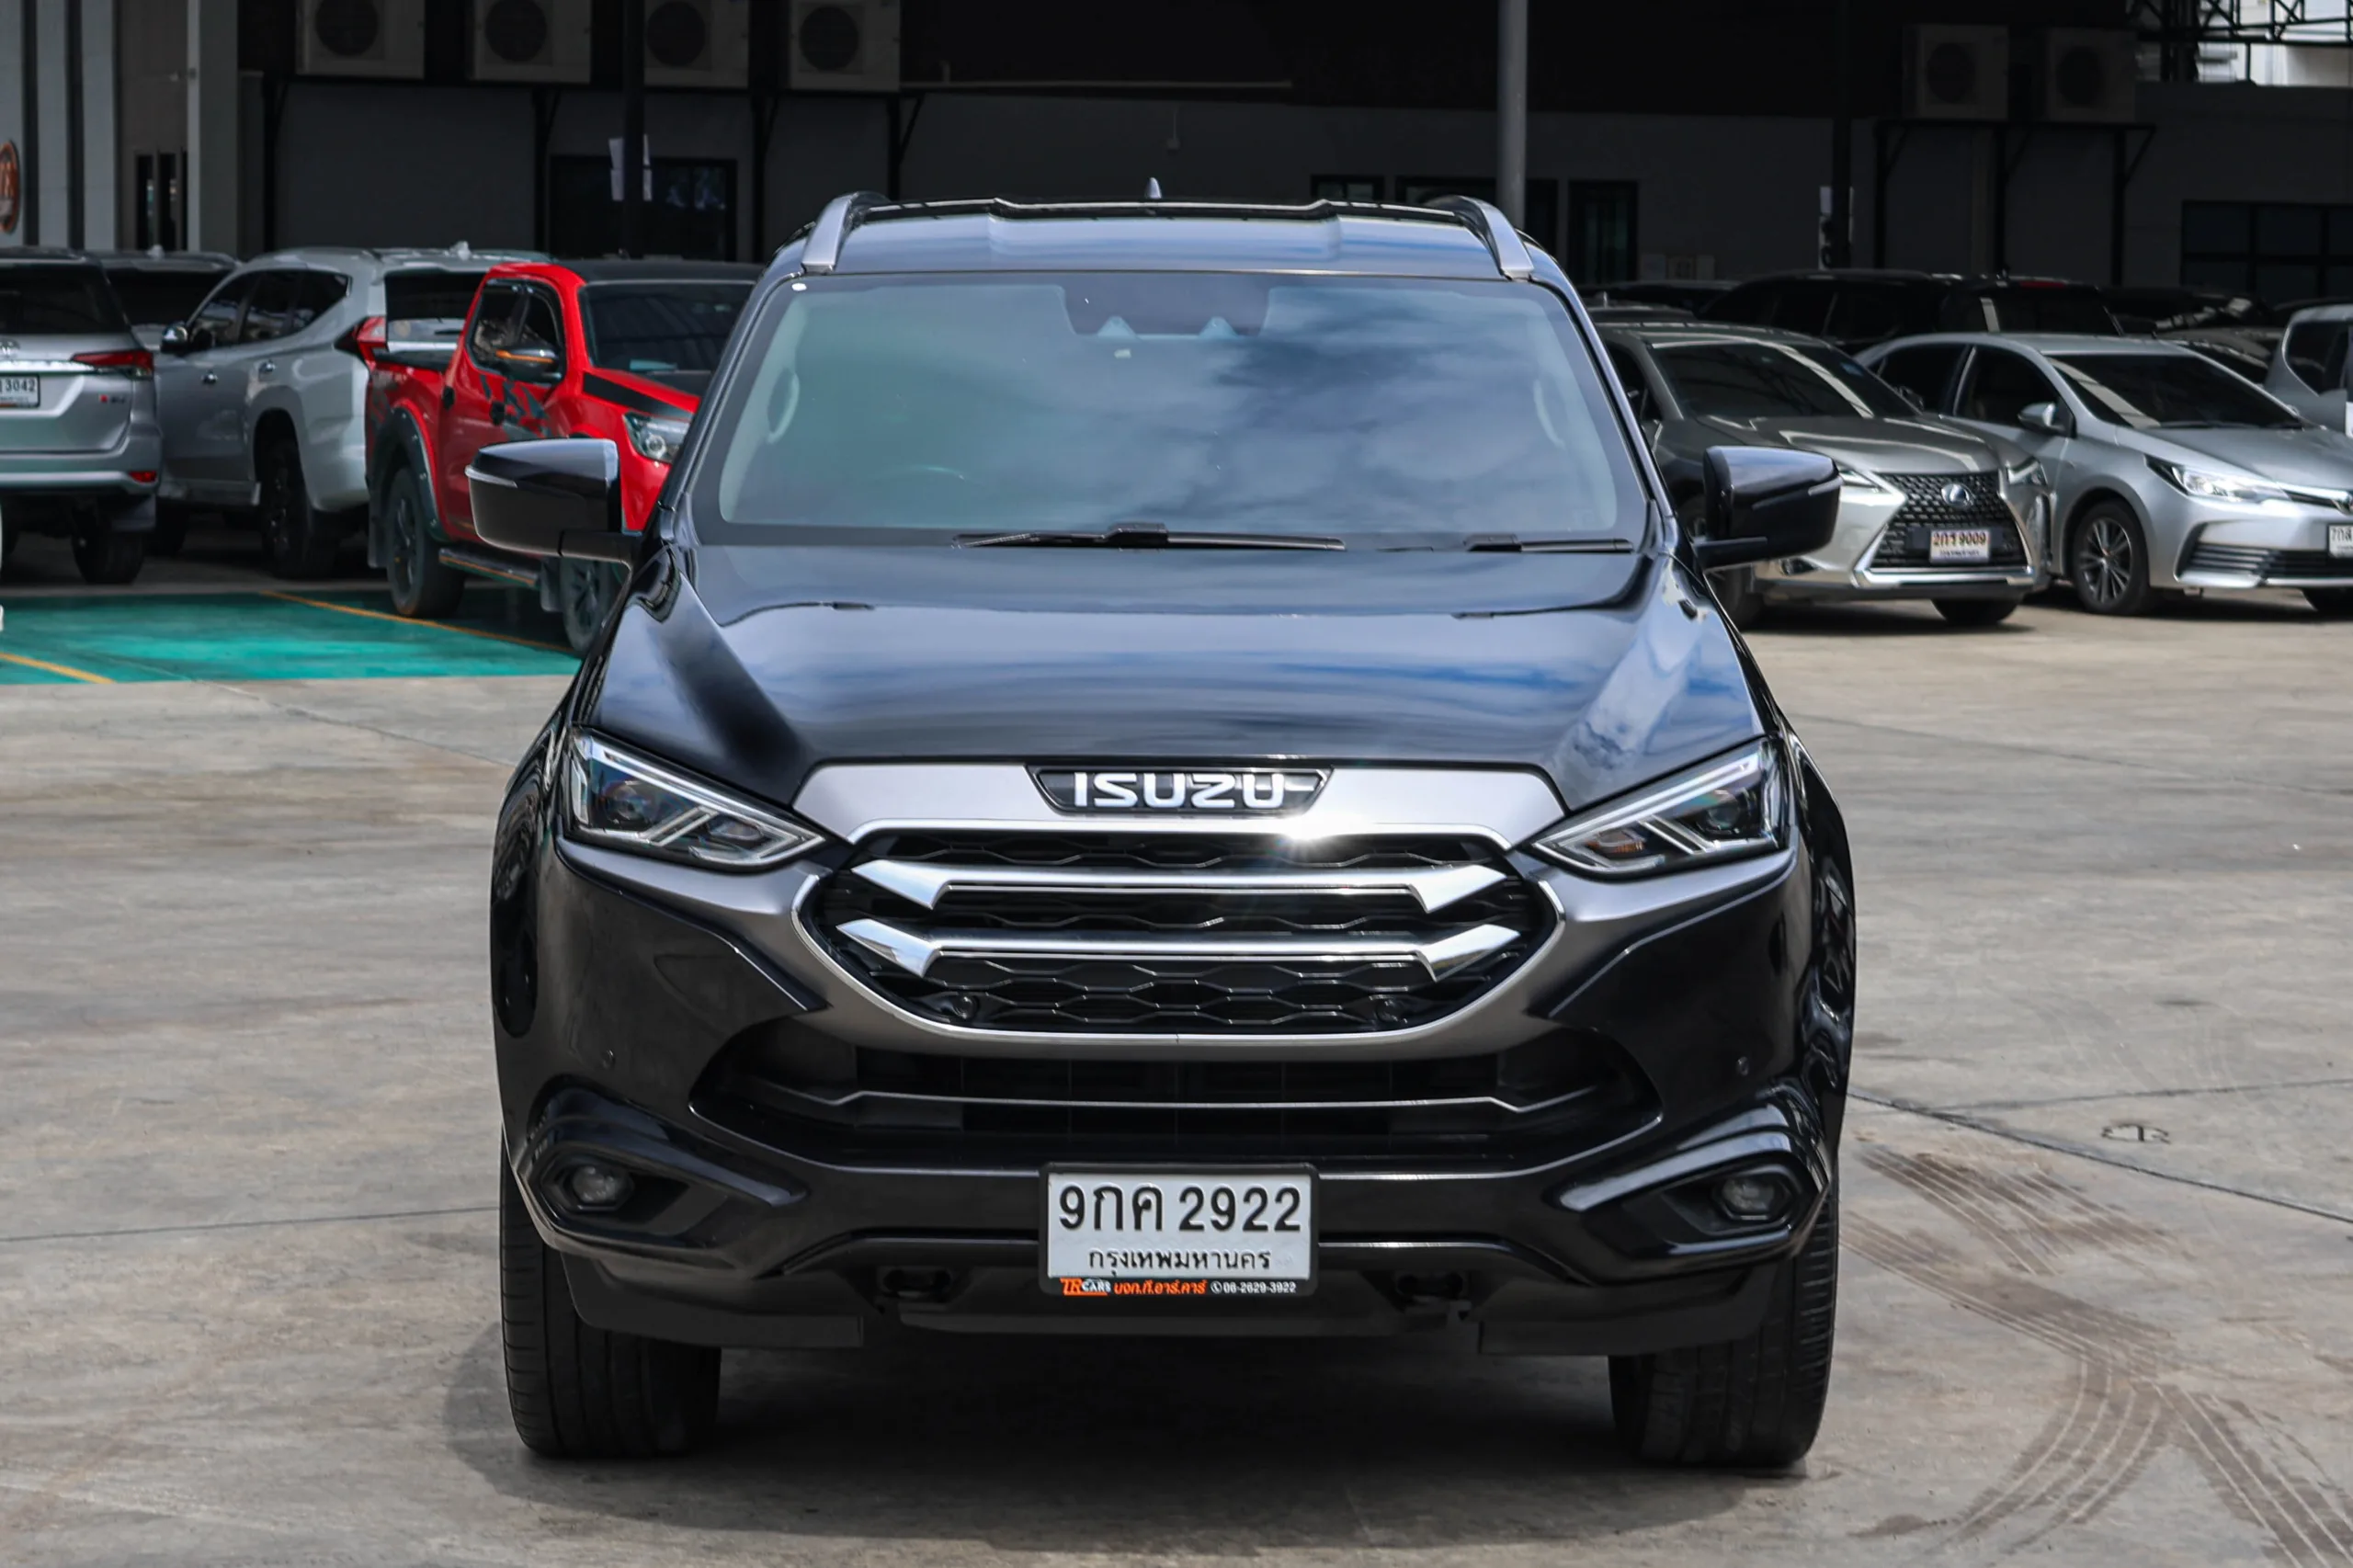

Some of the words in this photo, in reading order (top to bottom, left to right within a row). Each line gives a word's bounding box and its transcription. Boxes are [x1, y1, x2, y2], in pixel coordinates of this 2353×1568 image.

[6, 377, 36, 392] 3042
[1074, 771, 1285, 809] ISUZU
[1059, 1185, 1164, 1232] 9กค
[1178, 1186, 1302, 1232] 2922
[1088, 1249, 1272, 1276] กรุงเทพมหานคร
